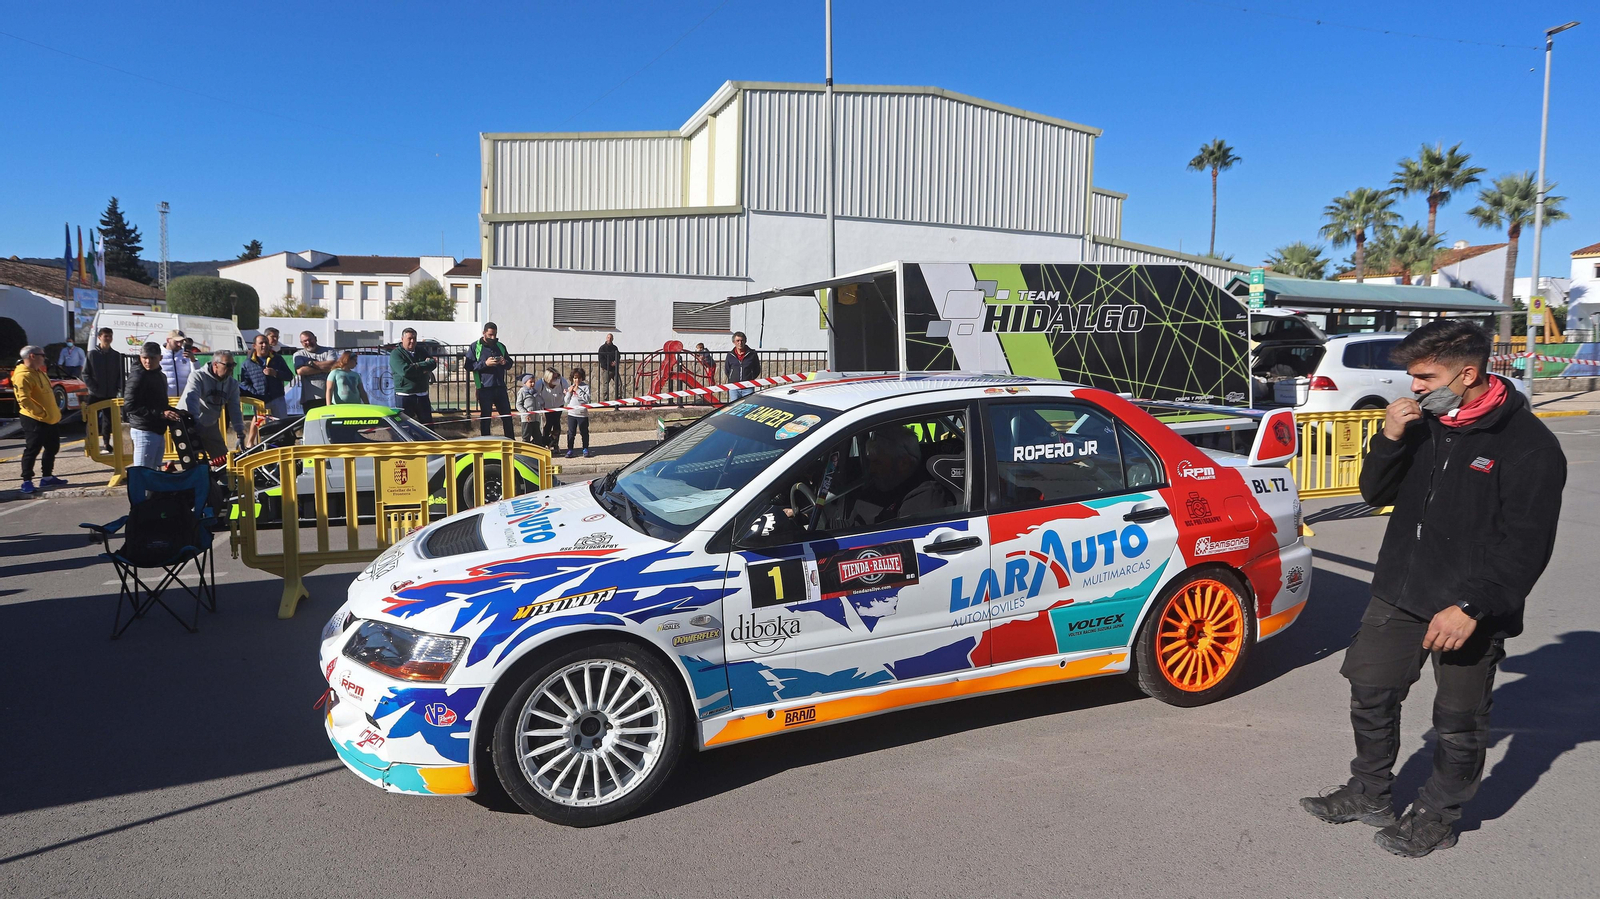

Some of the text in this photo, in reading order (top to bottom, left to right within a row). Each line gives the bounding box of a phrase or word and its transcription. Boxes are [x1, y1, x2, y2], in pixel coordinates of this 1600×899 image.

[1017, 290, 1060, 301] TEAM
[113, 320, 164, 329] SUPERMERCADO
[982, 303, 1147, 333] HIDALGO
[744, 406, 794, 428] CAMPER
[1013, 440, 1098, 462] ROPERO JR
[1183, 467, 1215, 478] RPM
[1209, 537, 1249, 550] SAMSONAS
[767, 566, 784, 601] 1
[1082, 559, 1151, 588] MULTIMARCAS
[511, 588, 618, 621] MISHIMOTO
[951, 597, 1026, 628] AUTOMOVILES
[731, 613, 801, 641] diboka
[1068, 613, 1126, 631] VOLTEX
[673, 629, 720, 646] POWERFLEX
[341, 678, 365, 697] RPM
[784, 708, 816, 724] BRAID
